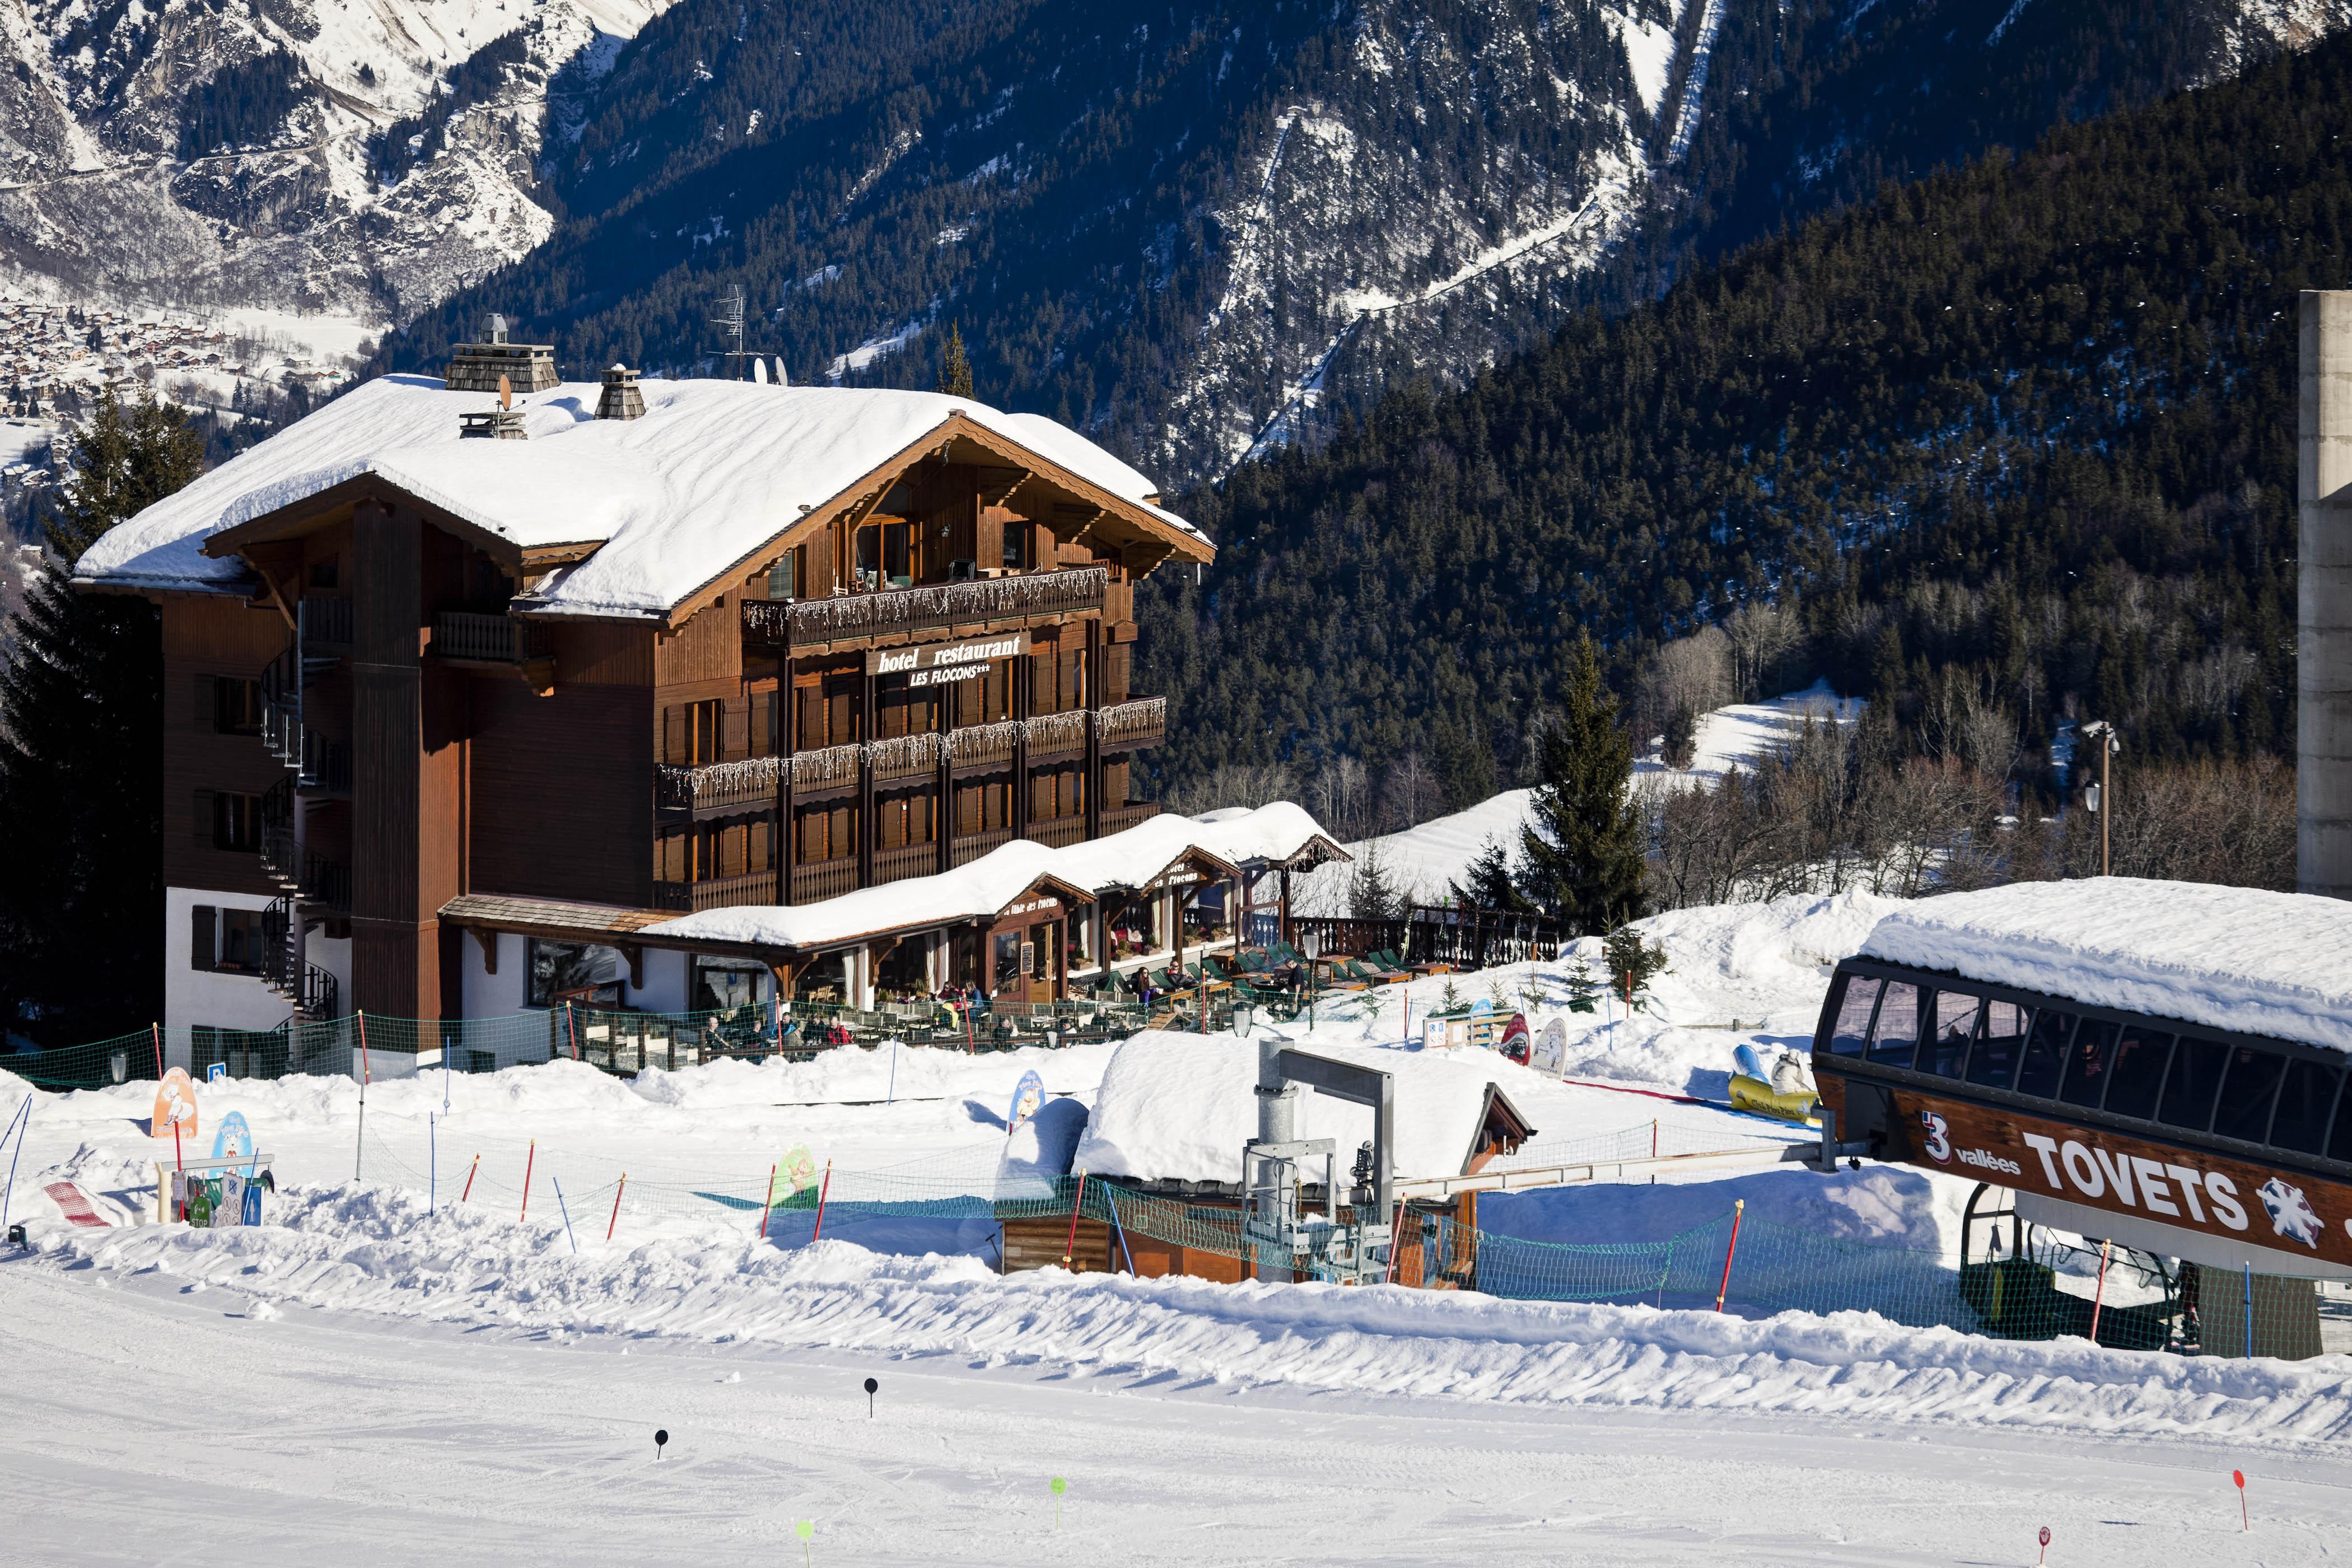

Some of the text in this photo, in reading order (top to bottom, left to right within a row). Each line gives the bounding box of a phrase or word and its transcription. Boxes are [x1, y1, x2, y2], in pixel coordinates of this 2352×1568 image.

[878, 636, 1021, 673] hotel restaurant
[909, 672, 928, 687] LES
[1026, 902, 1036, 912] des
[1922, 1110, 2022, 1175] 3 vallées
[2023, 1132, 2249, 1230] TOVETS
[192, 1217, 208, 1227] STOP
